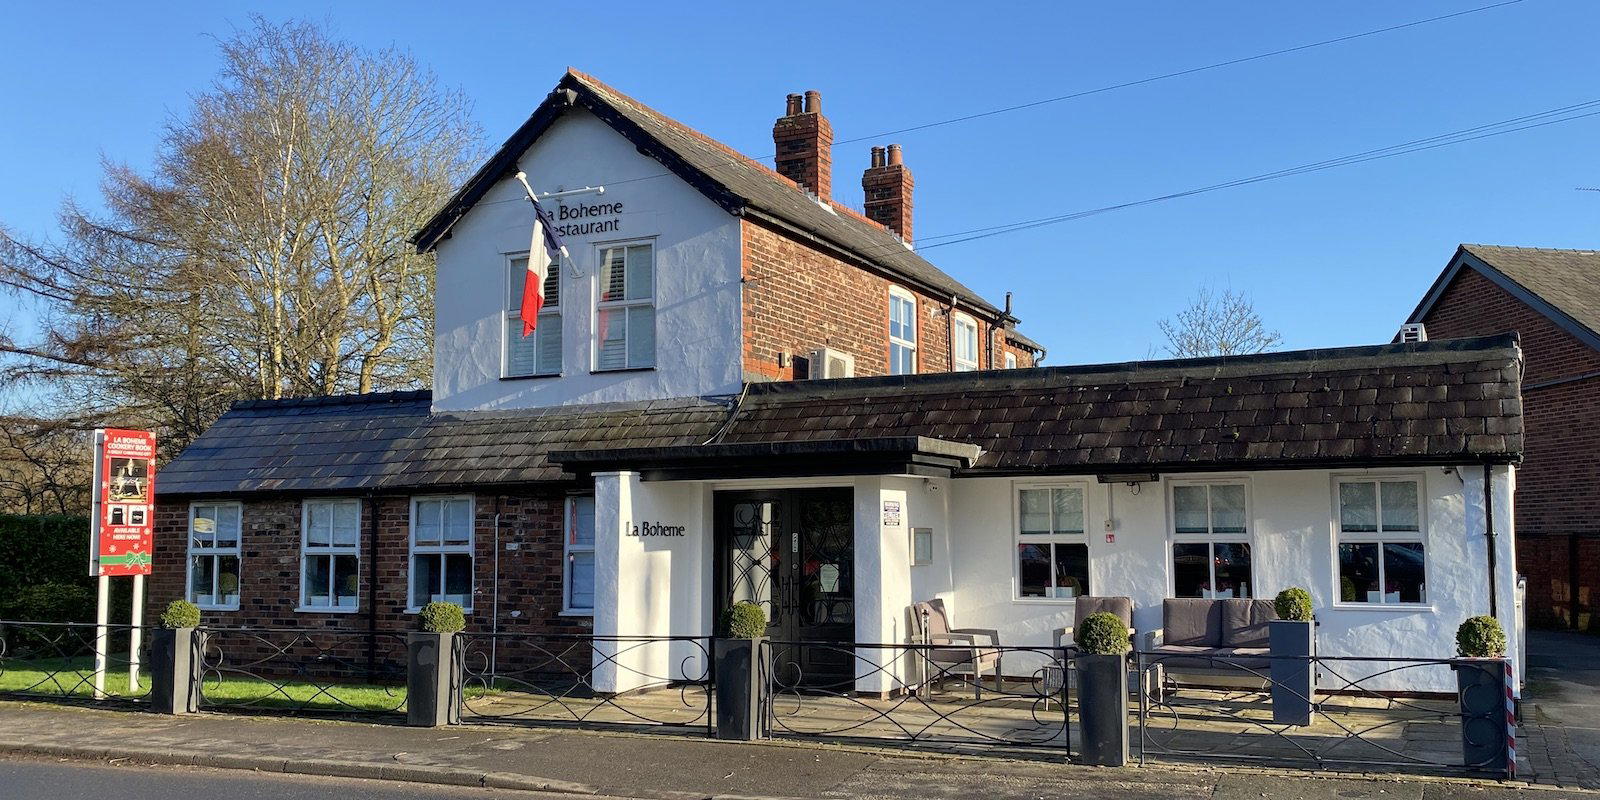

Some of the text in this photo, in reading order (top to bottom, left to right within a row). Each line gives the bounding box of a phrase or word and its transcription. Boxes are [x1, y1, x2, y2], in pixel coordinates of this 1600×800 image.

[560, 202, 623, 220] Boheme
[553, 217, 619, 237] estaurant
[626, 521, 685, 537] La Boheme
